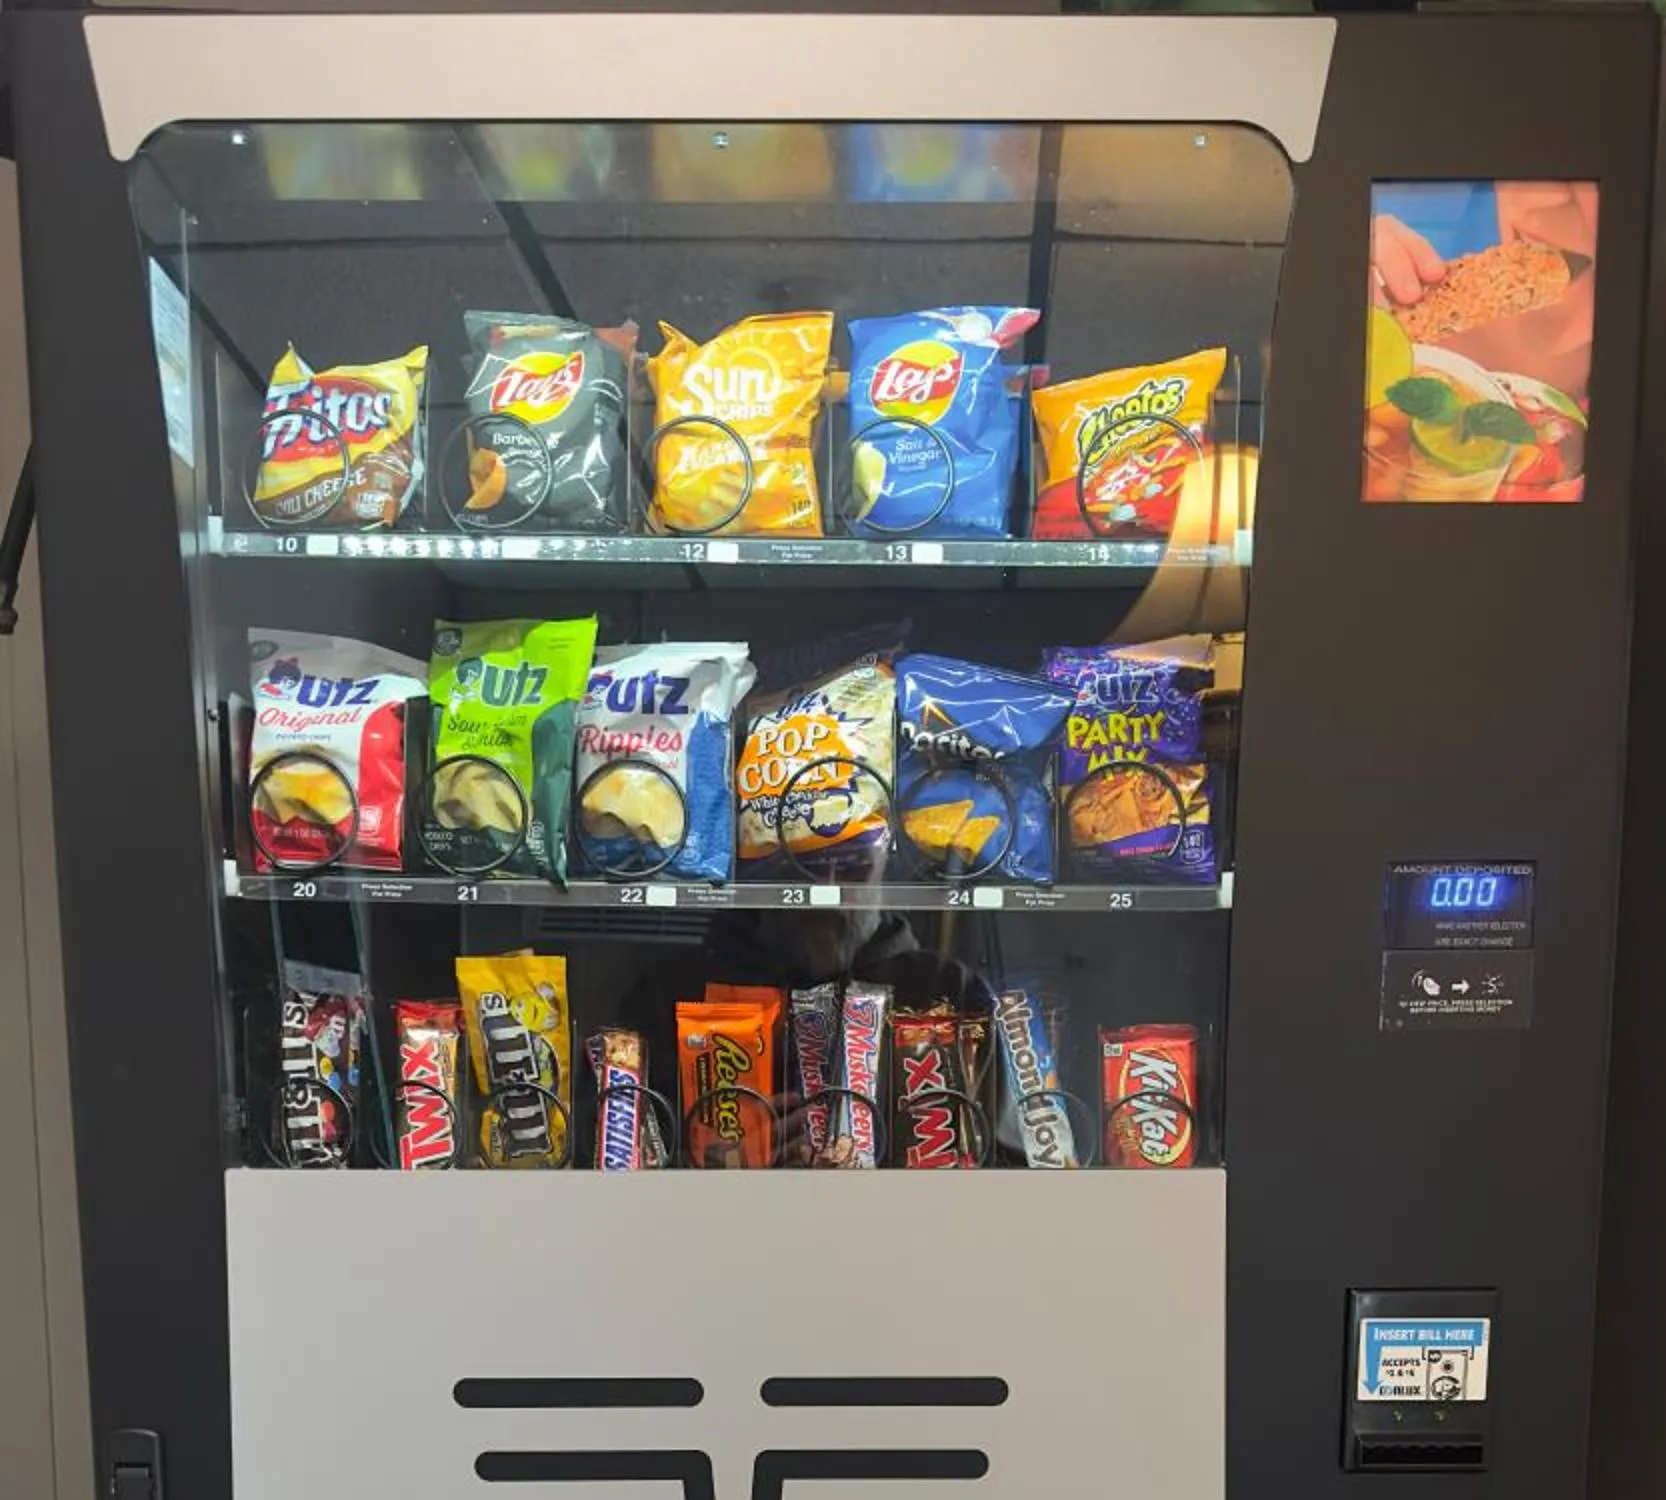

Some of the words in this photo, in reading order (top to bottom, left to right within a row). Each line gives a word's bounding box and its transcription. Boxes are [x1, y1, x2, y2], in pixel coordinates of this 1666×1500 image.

[683, 364, 778, 415] Sun
[875, 361, 954, 404] Lay's
[896, 439, 922, 451] Salt
[889, 450, 943, 466] Vinegar
[276, 538, 297, 552] 10
[684, 545, 705, 559] 12
[885, 546, 907, 560] 13
[259, 707, 362, 731] Original
[1067, 710, 1166, 749] PARTY
[577, 724, 683, 762] Ripples
[757, 721, 831, 756] POP
[293, 882, 317, 898] 20
[458, 886, 479, 900] 21
[621, 889, 643, 903] 22
[783, 889, 804, 904] 23
[1431, 876, 1497, 907] 0.00
[949, 891, 970, 905] 24
[1110, 893, 1133, 908] 25
[1374, 1327, 1415, 1341] INSERT
[1418, 1328, 1442, 1341] BILL
[1445, 1328, 1475, 1341] HERE
